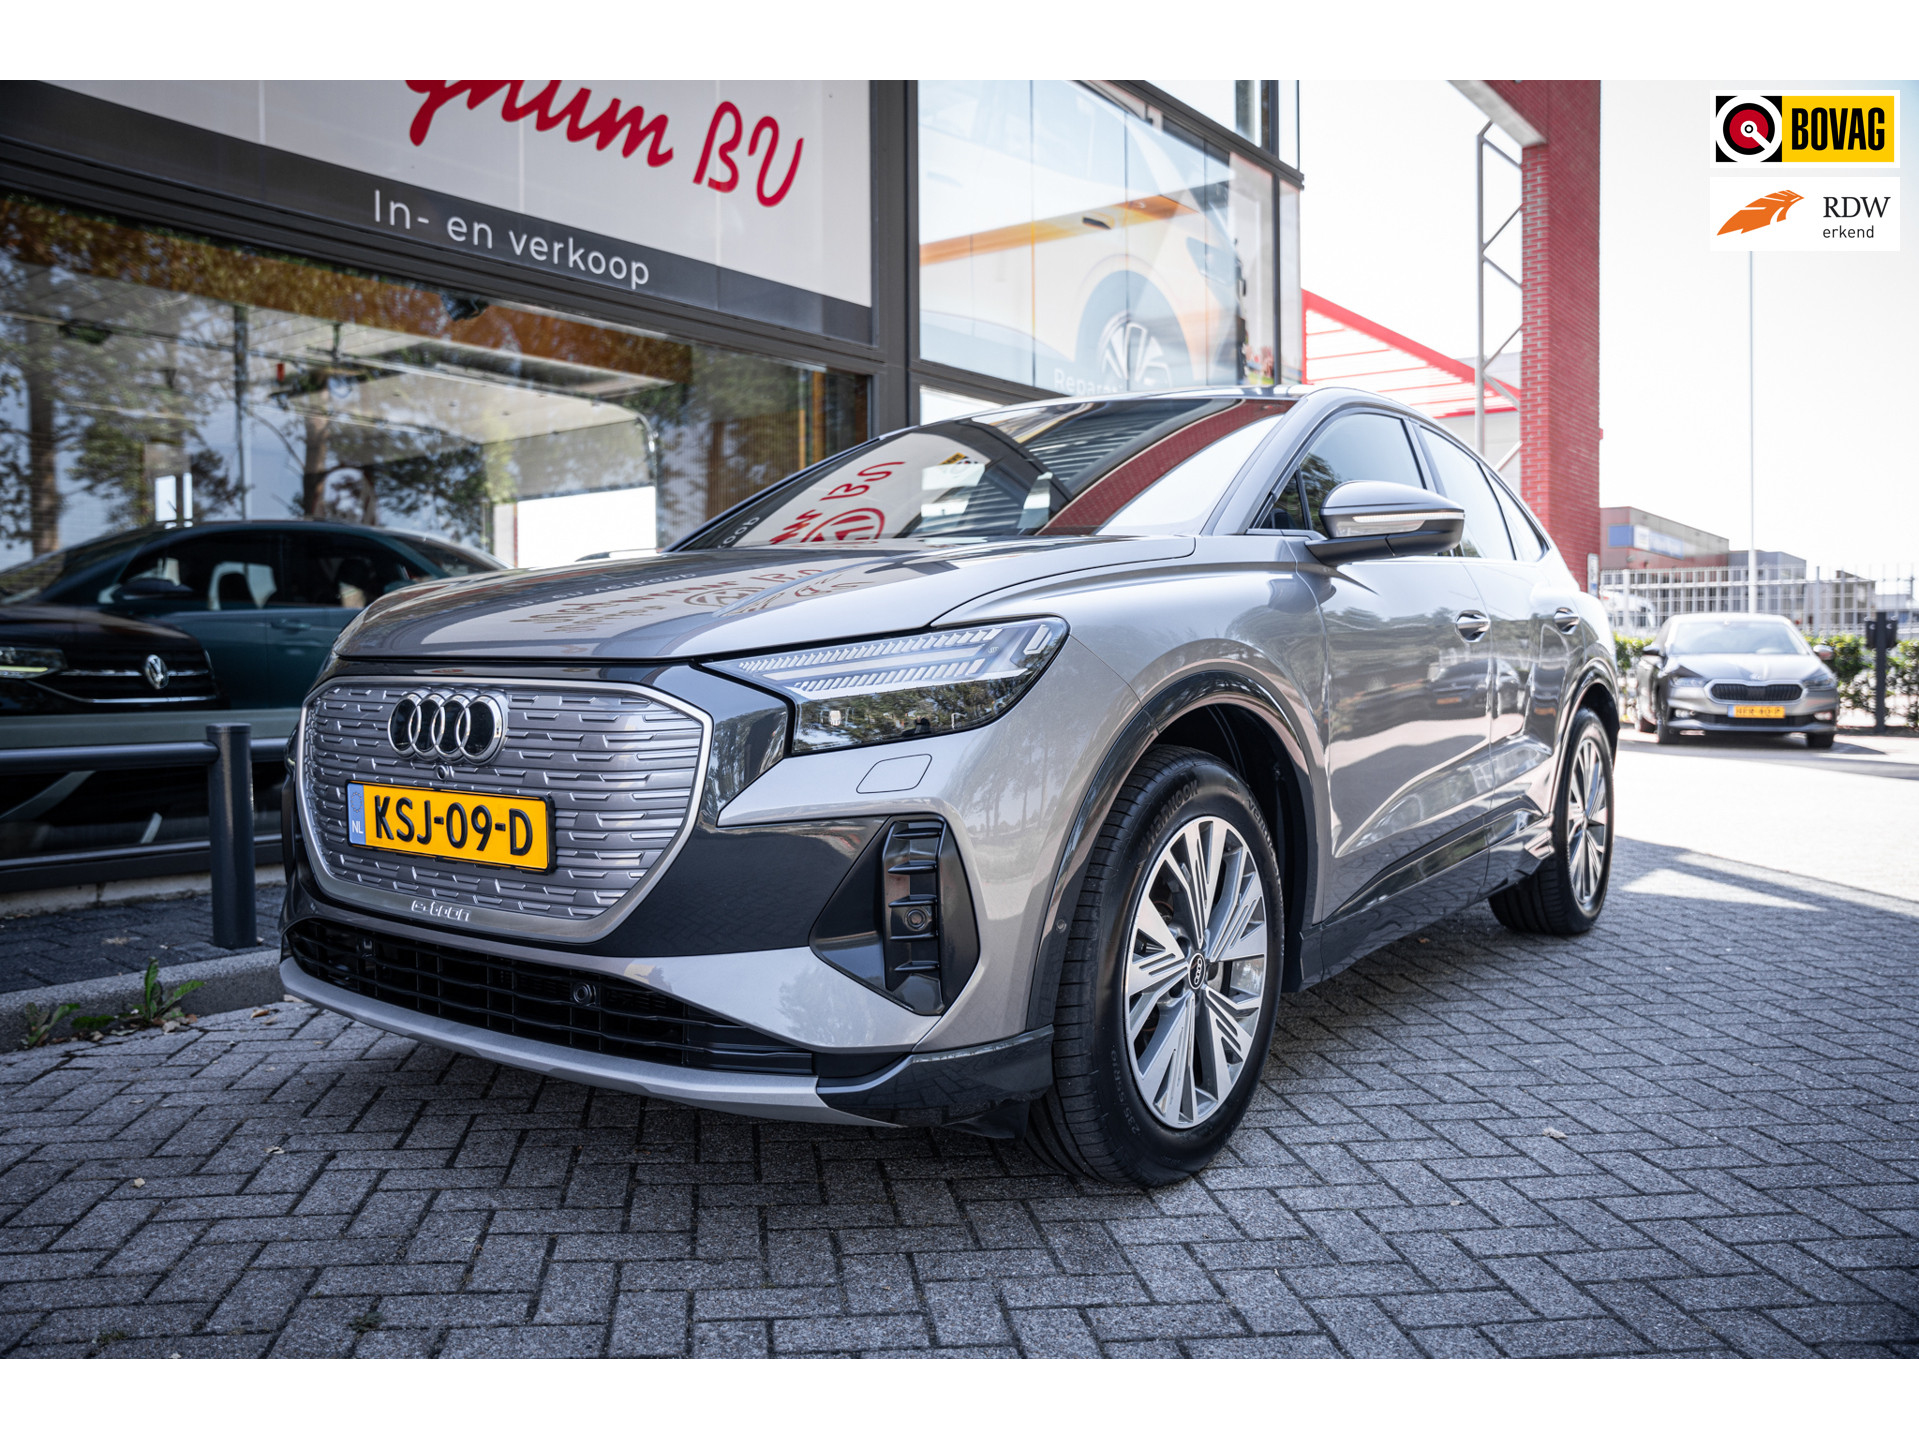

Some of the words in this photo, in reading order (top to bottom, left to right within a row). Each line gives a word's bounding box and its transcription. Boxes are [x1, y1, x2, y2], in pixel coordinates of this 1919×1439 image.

[374, 189, 430, 229] In-
[447, 216, 493, 249] en
[508, 230, 649, 290] verkoop
[351, 819, 364, 834] NL
[374, 794, 533, 857] KSJ-09-D
